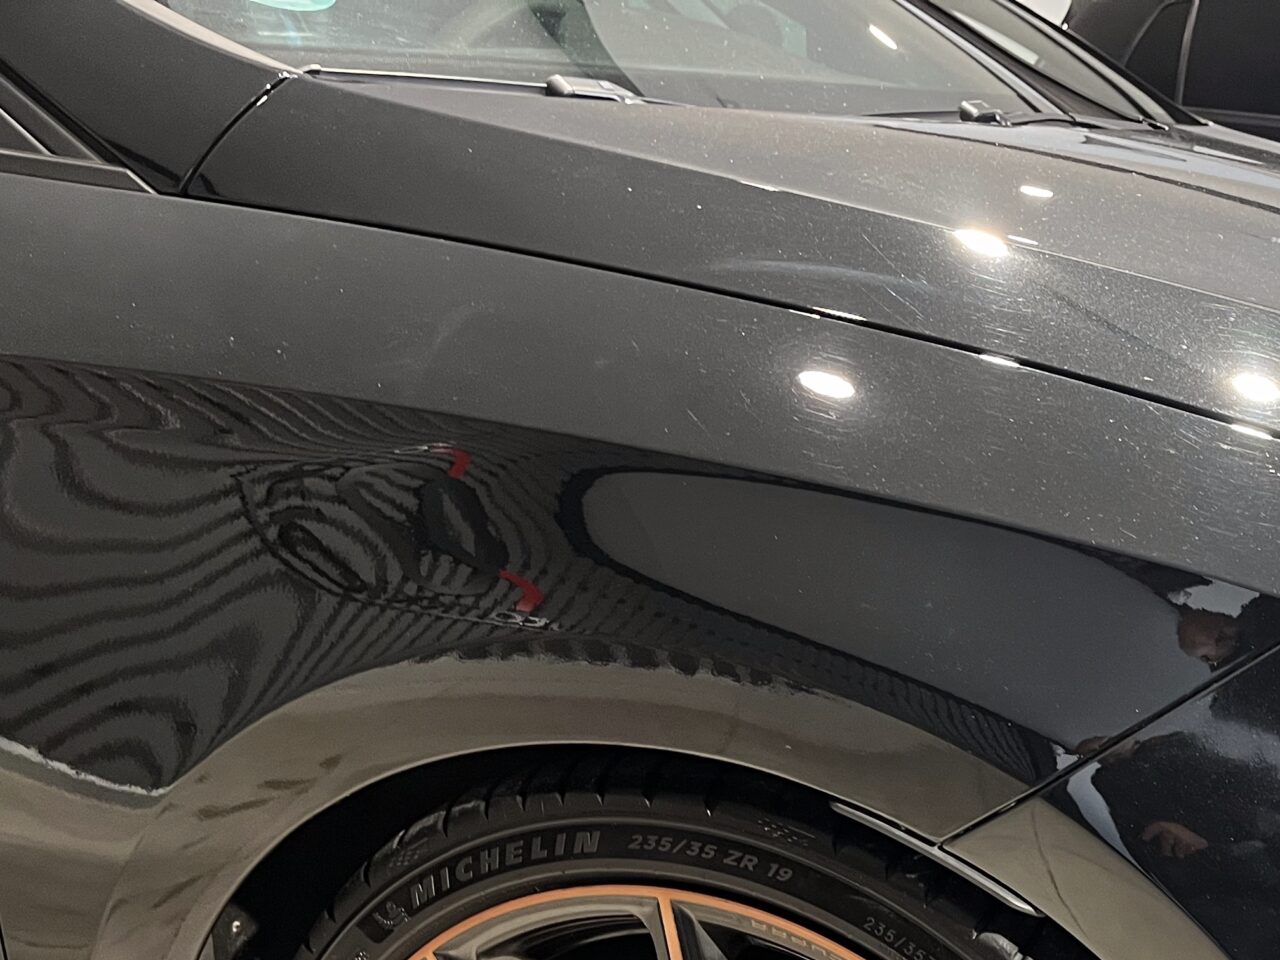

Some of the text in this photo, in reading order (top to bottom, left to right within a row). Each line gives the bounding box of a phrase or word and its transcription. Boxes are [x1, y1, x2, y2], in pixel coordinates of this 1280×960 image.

[409, 831, 600, 909] MICHELIN
[628, 834, 793, 882] 235/35 ZR 19
